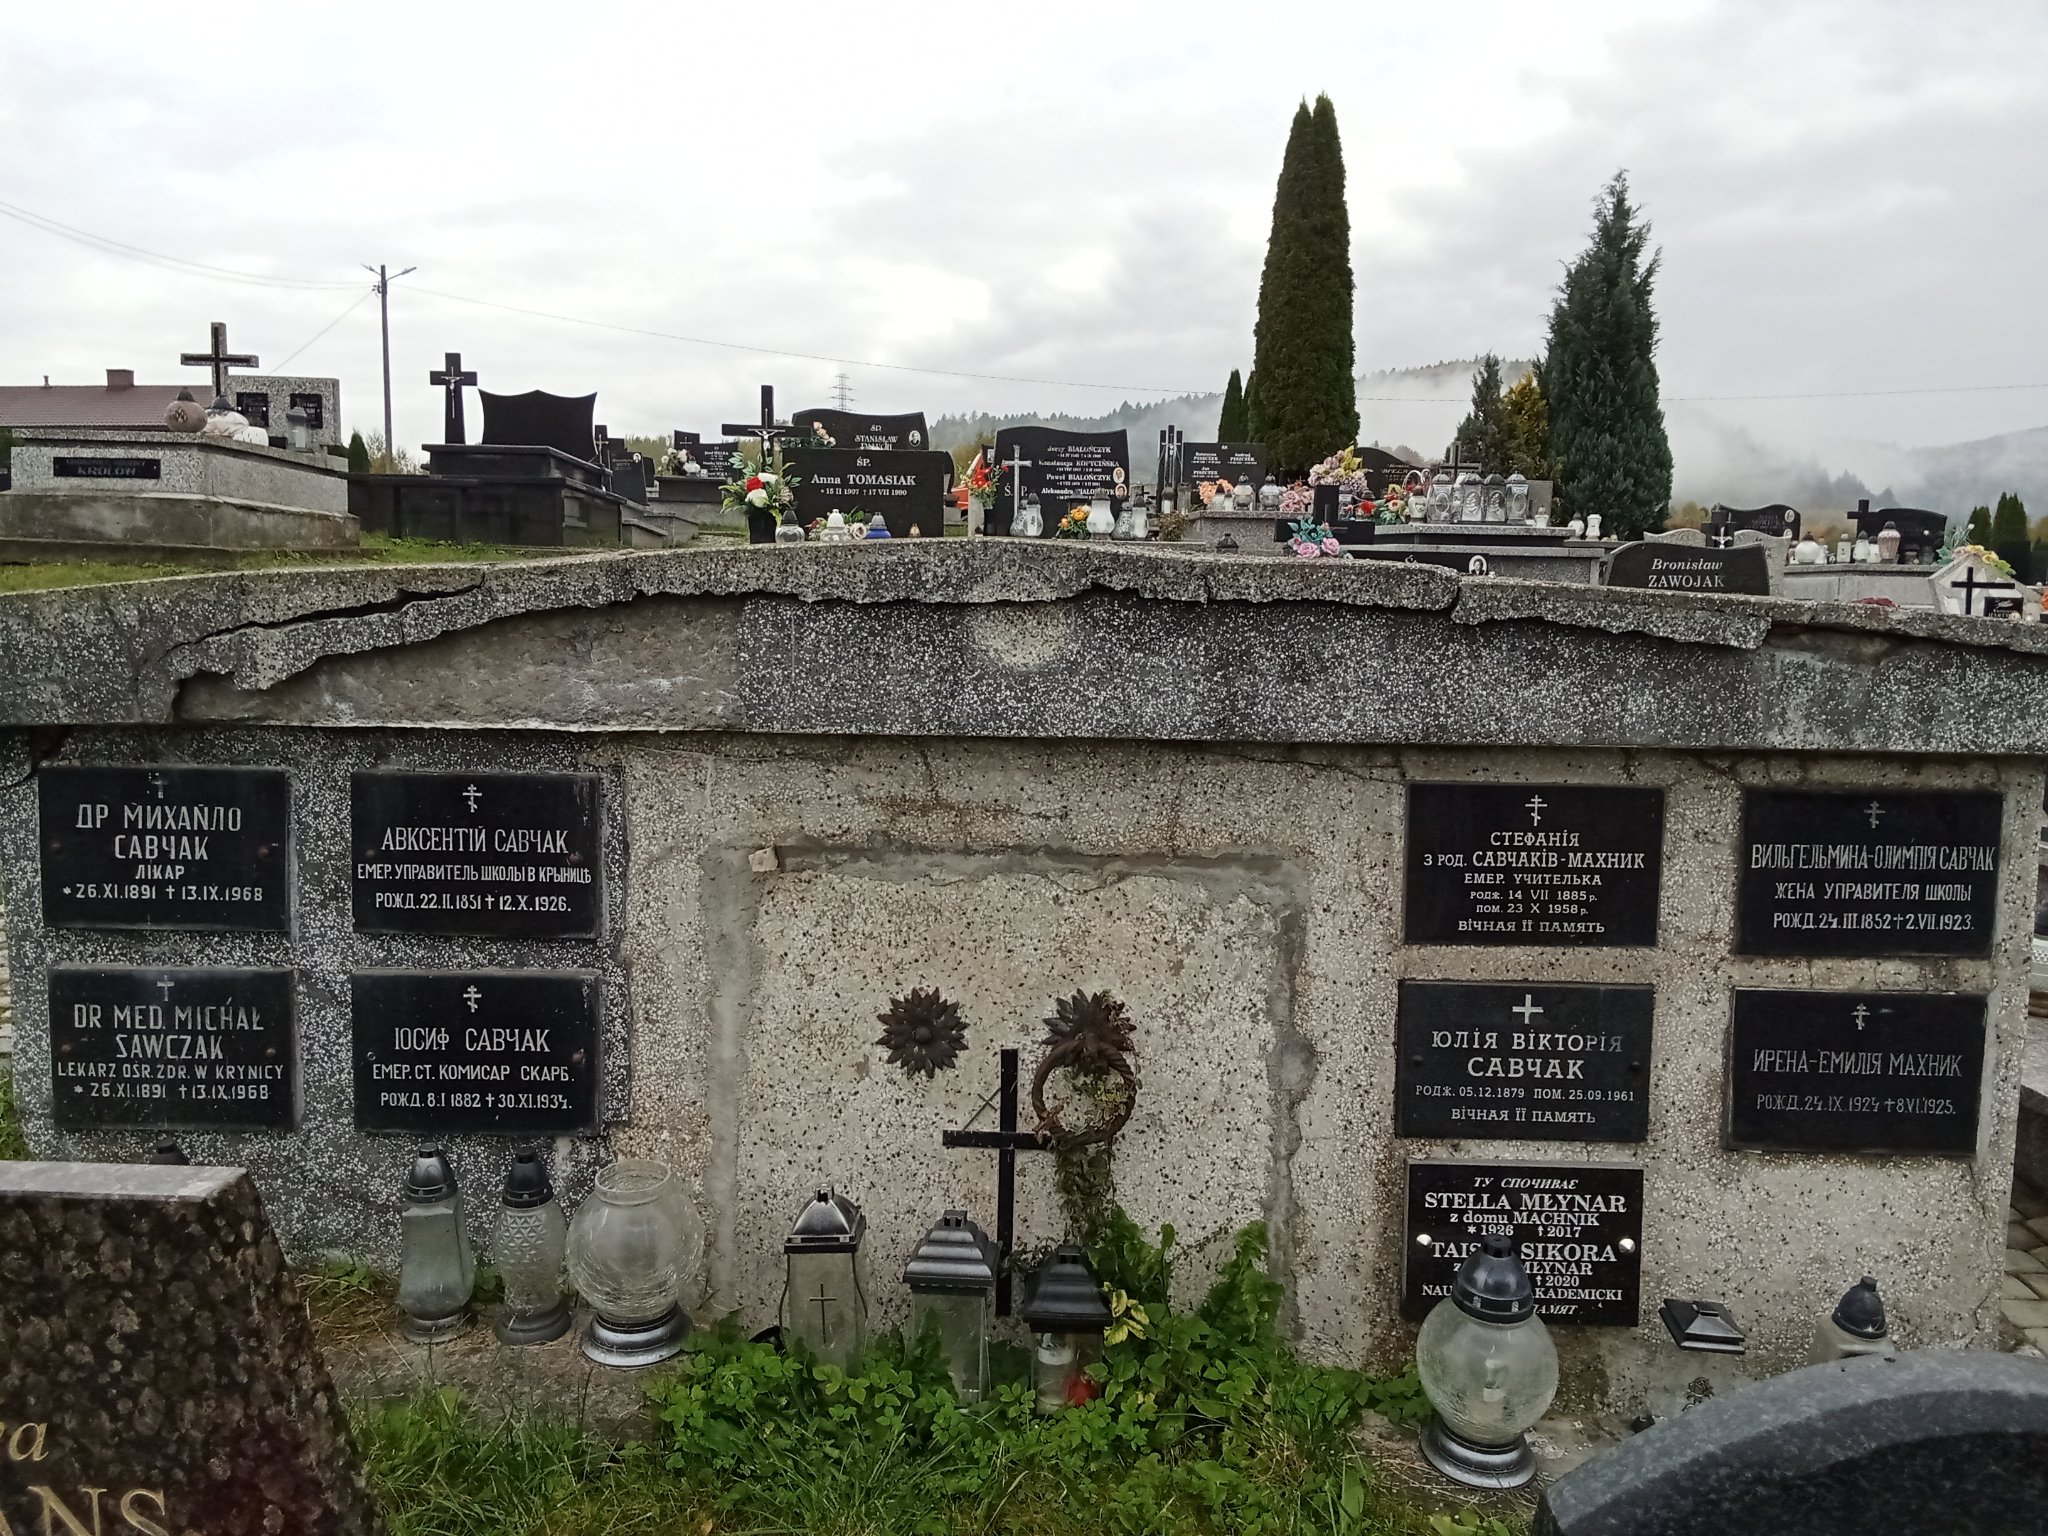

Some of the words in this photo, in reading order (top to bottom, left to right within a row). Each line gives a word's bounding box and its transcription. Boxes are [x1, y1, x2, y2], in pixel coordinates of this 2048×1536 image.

[856, 456, 872, 467] ŚP.
[811, 474, 841, 484] Anna
[847, 474, 916, 486] TOMASIAK
[1651, 558, 1723, 571] Bronisław
[1648, 575, 1725, 588] ZAWOJAK
[76, 804, 109, 829] ДР
[114, 834, 209, 861] САВЧАК
[381, 825, 487, 852] АВКСЕНТІЙ
[494, 828, 569, 854] САВЧАК
[1437, 854, 1467, 868] РОД.
[1939, 845, 1996, 871] САВЧАК
[135, 864, 185, 880] ЛІКАР
[481, 866, 526, 882] ШКОЛЫ
[528, 867, 536, 882] В
[1464, 873, 1505, 885] ЕМЕР.
[1513, 873, 1602, 886] УЧИТЕЛЬКА
[1508, 890, 1523, 900] 14
[1530, 890, 1549, 901] VII
[1557, 890, 1587, 901] 1885
[1774, 882, 1815, 899] ЖЕНА
[1824, 883, 1919, 900] УПРАВИТЕЛЯ
[1925, 884, 1972, 901] ШКОЛЫ
[1507, 903, 1523, 914] 23
[1548, 904, 1579, 915] 1958
[1539, 921, 1605, 933] ПАМЯТЬ
[74, 1003, 102, 1028] DR
[114, 1004, 166, 1030] MED.
[175, 1004, 265, 1031] MICHAŁ
[115, 1034, 224, 1059] SAWCZAK
[394, 1027, 450, 1051] ІОСИФ
[465, 1028, 551, 1052] САВЧАК
[58, 1062, 116, 1078] LEKARZ
[194, 1065, 208, 1079] W
[216, 1065, 284, 1080] KRYNICY
[1467, 1057, 1585, 1080] САВЧАК
[1888, 1053, 1962, 1077] МАХНИК
[439, 1065, 511, 1081] КОМИСАР
[520, 1066, 575, 1082] СКАРБ.
[1416, 1085, 1455, 1097] РОДЖ.
[1459, 1086, 1525, 1098] 05.12.1879
[1534, 1088, 1565, 1100] ПОМ.
[1569, 1089, 1635, 1102] 25.09.1961
[1532, 1110, 1596, 1123] ПАМЯТЬ
[1474, 1176, 1493, 1188] ТУ
[1501, 1178, 1579, 1190] СПОЧИВАЄ
[1424, 1192, 1512, 1210] STELLA
[1520, 1193, 1627, 1213] MŁYNAR
[1450, 1213, 1458, 1223] z
[1465, 1210, 1509, 1224] domu
[1513, 1212, 1600, 1226] MACHNIK
[1480, 1225, 1514, 1236] 1926
[1547, 1226, 1582, 1238] 2017
[1520, 1243, 1618, 1262] SIKORA
[1545, 1275, 1580, 1287] 2020
[1532, 1288, 1623, 1301] KADEMICKI
